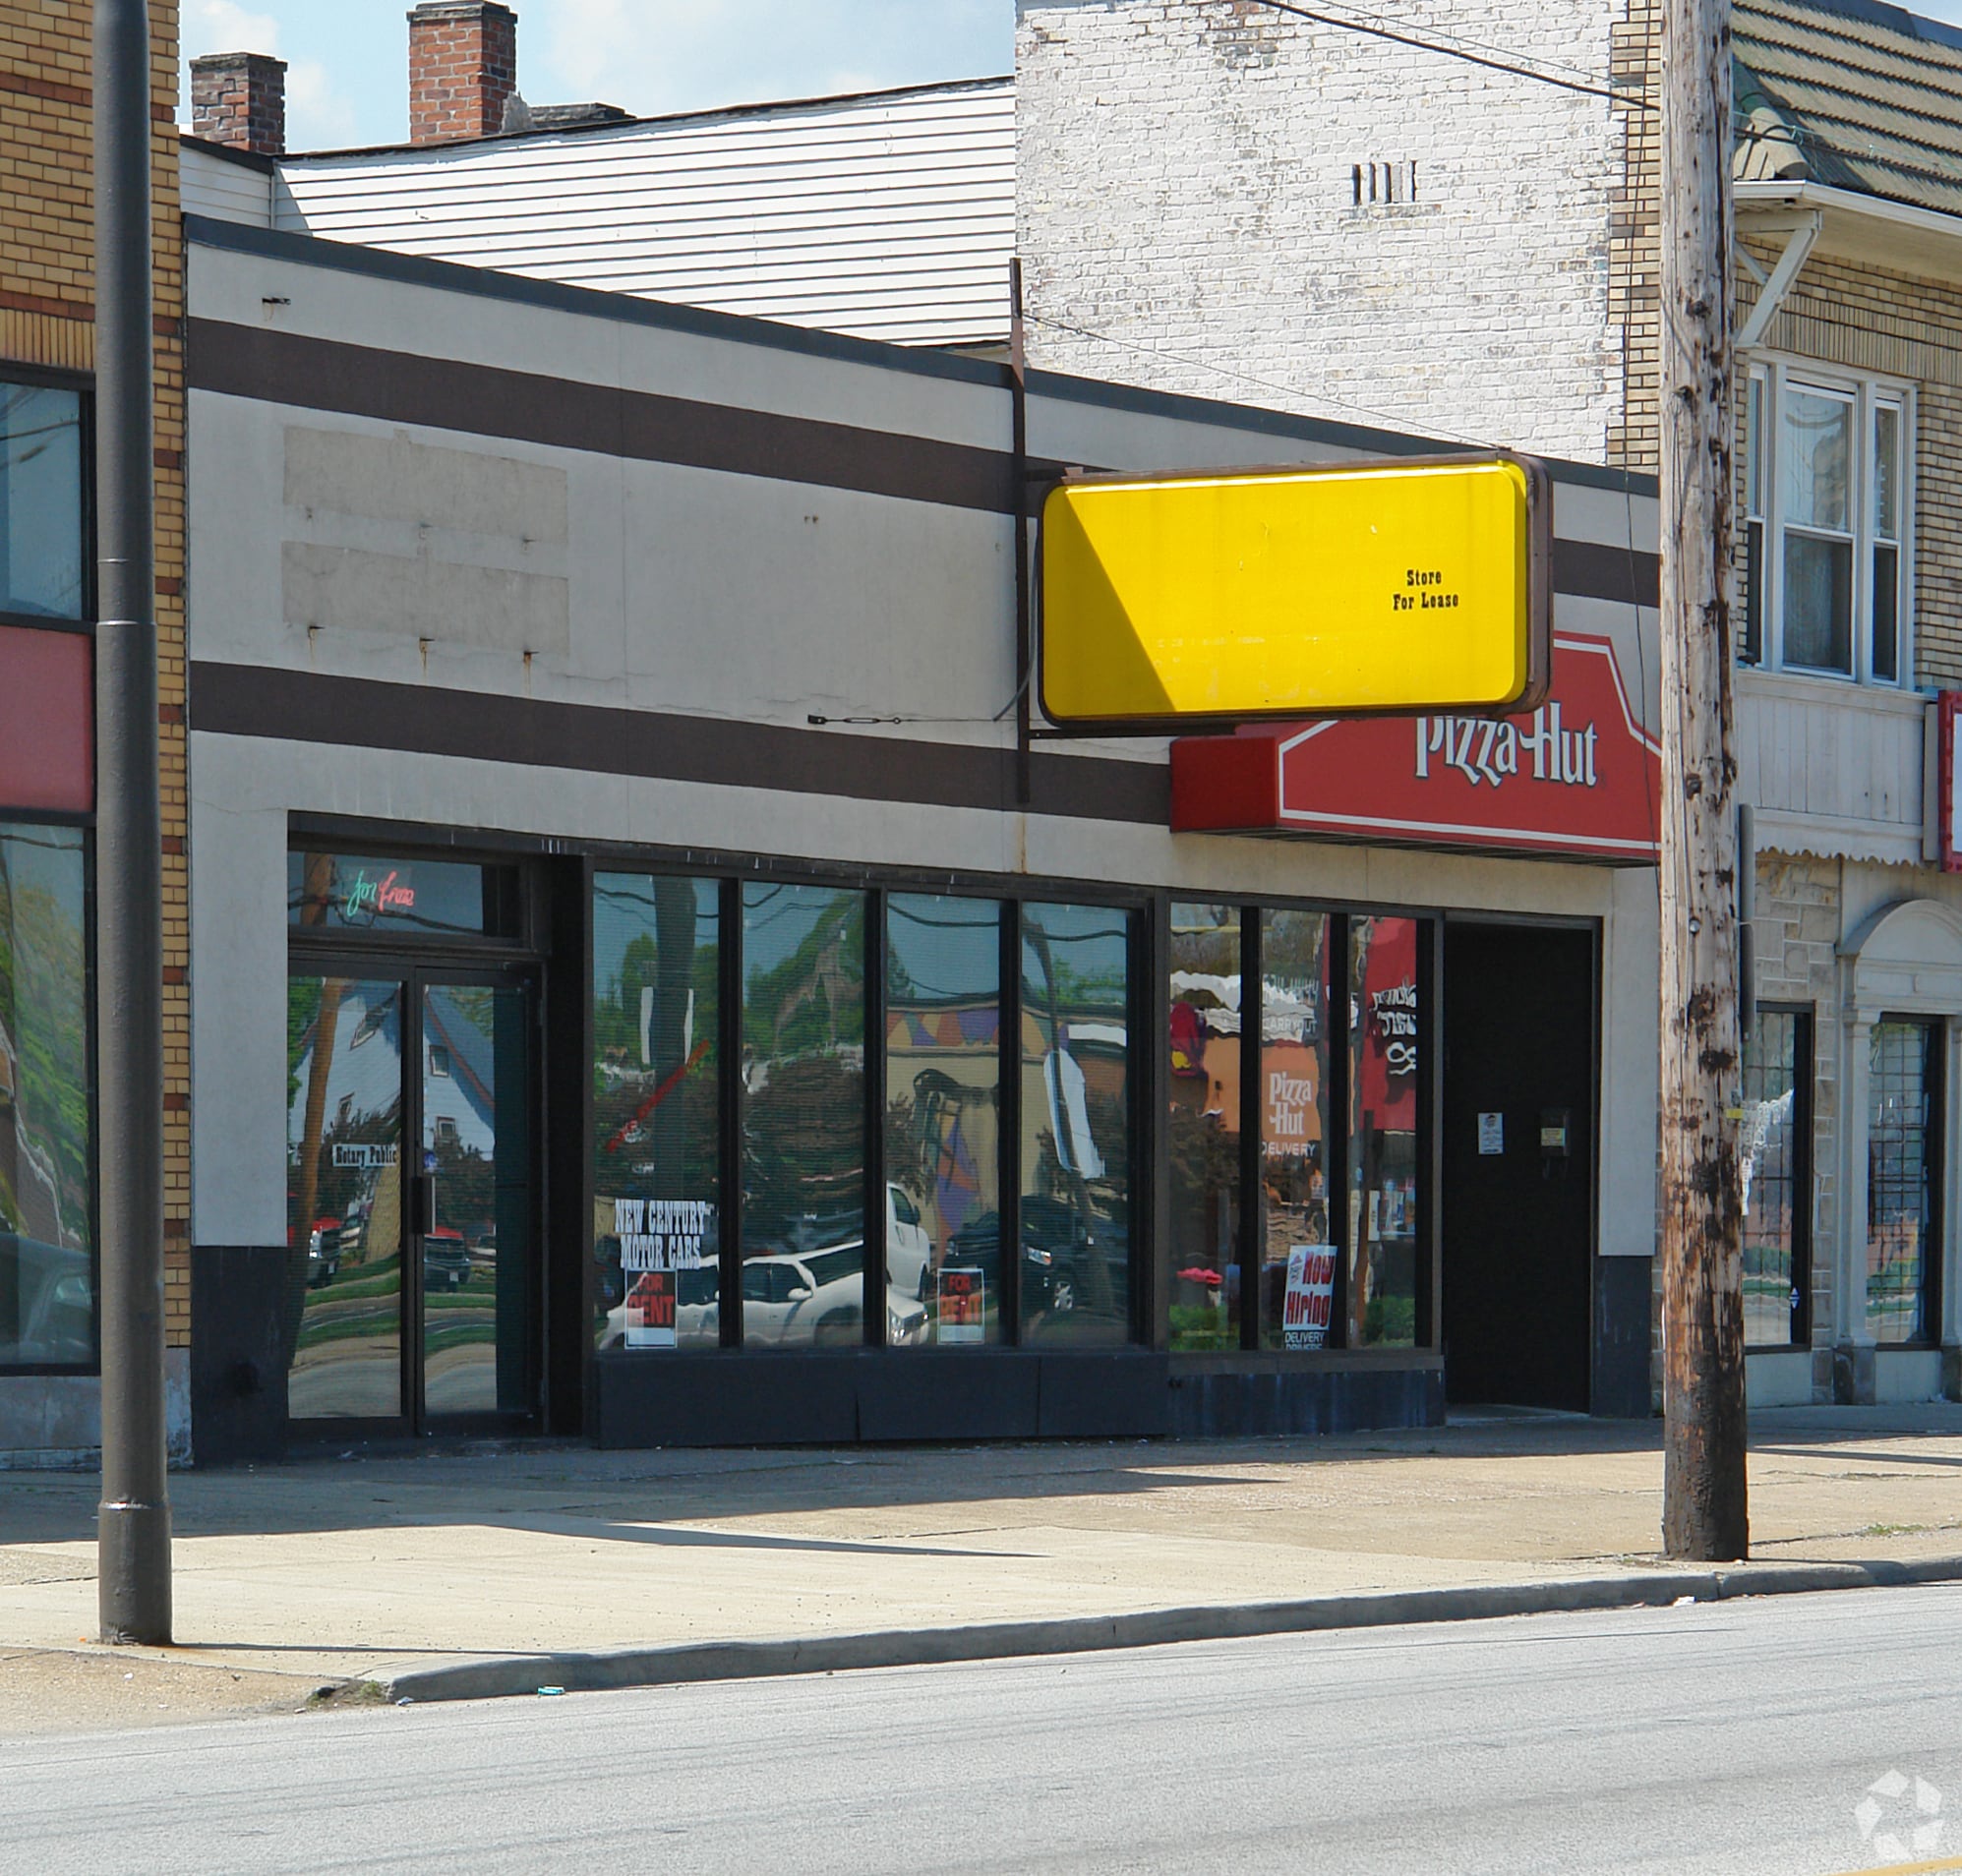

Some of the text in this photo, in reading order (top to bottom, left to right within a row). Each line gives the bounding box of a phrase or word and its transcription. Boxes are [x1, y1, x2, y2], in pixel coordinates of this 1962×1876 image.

[1407, 569, 1442, 586] Store
[1393, 592, 1458, 611] For Lease
[1416, 701, 1597, 787] Pizza Hut
[1269, 1072, 1312, 1106] Pizza
[1269, 1101, 1304, 1135] Hut
[615, 1199, 705, 1234] NEW CENTURY
[621, 1235, 701, 1269] MOTOR CARS
[637, 1274, 664, 1291] FOR
[948, 1274, 971, 1291] FOR
[1286, 1291, 1330, 1327] Hiring
[1284, 1332, 1325, 1343] DELIVERY
